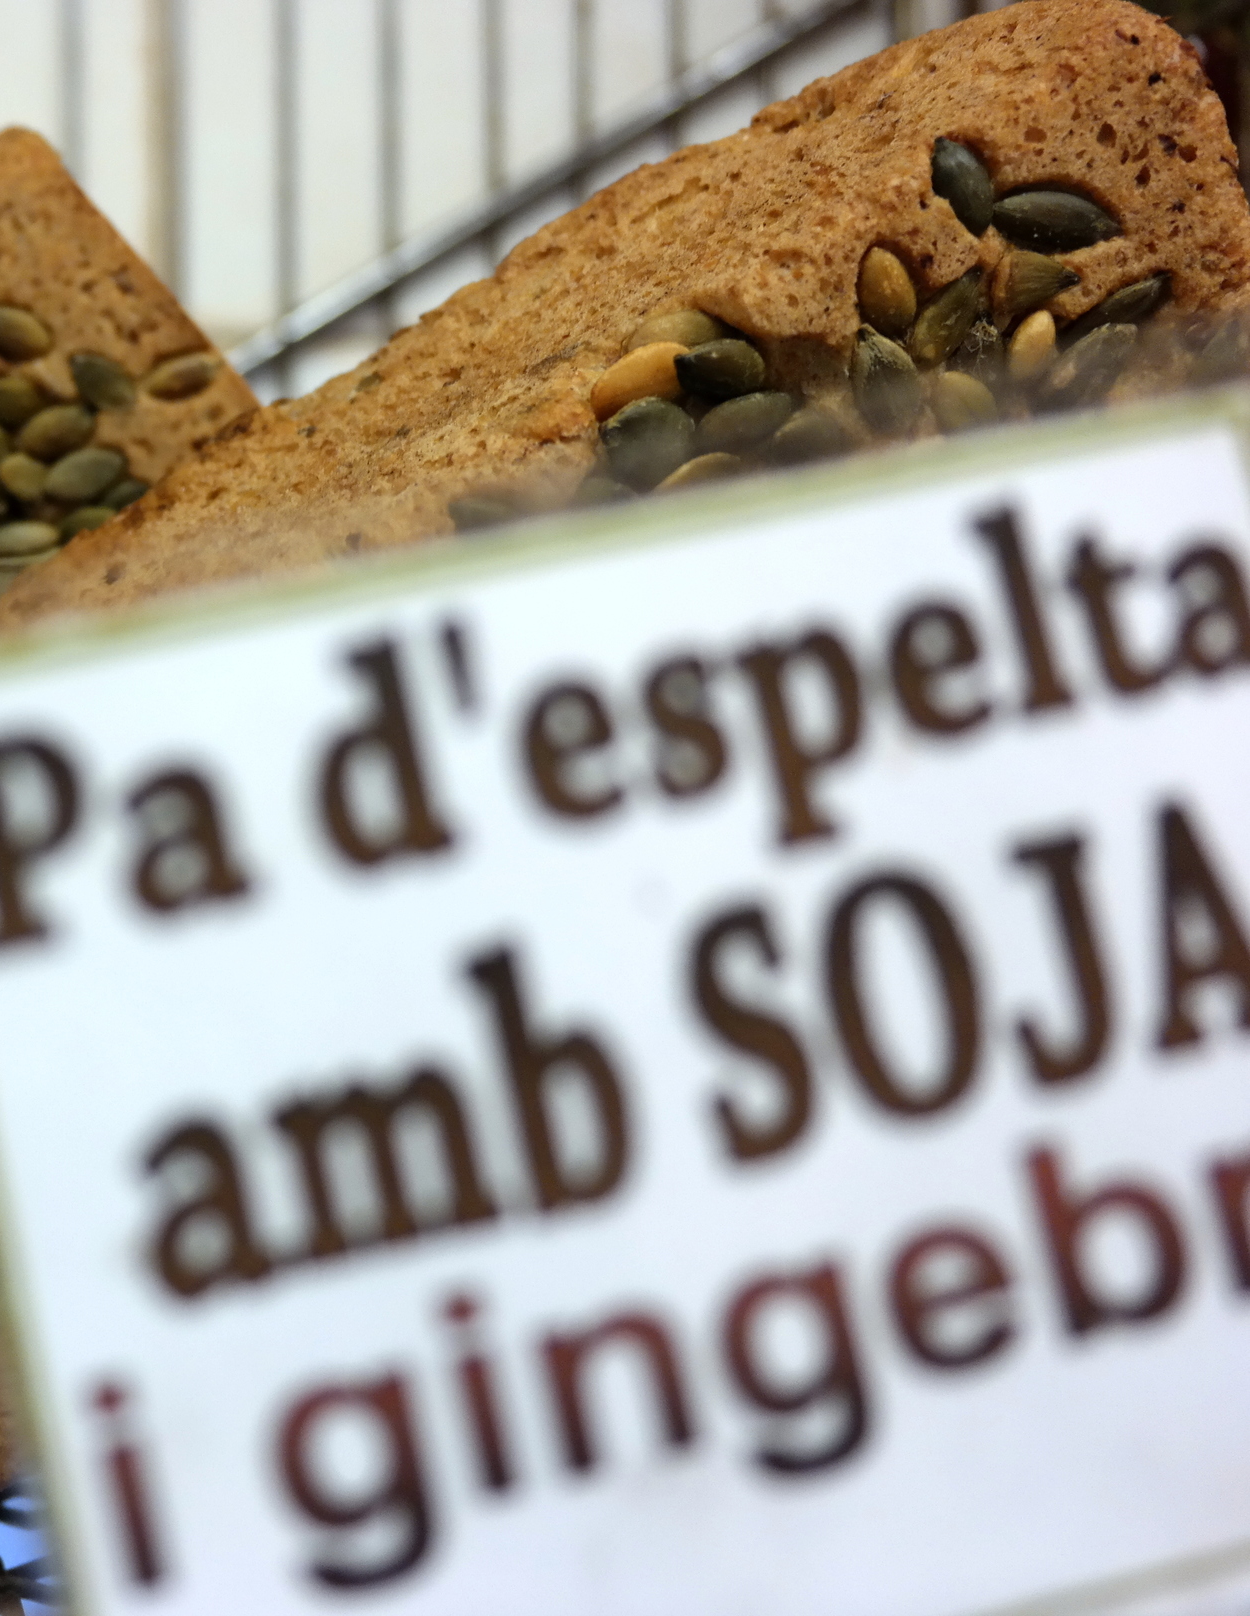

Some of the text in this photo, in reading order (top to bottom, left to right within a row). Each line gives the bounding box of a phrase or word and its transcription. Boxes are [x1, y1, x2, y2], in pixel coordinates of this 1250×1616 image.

[312, 500, 1250, 875] d'espelta
[142, 796, 1250, 1305] amb SOJA
[90, 1385, 166, 1592] i
